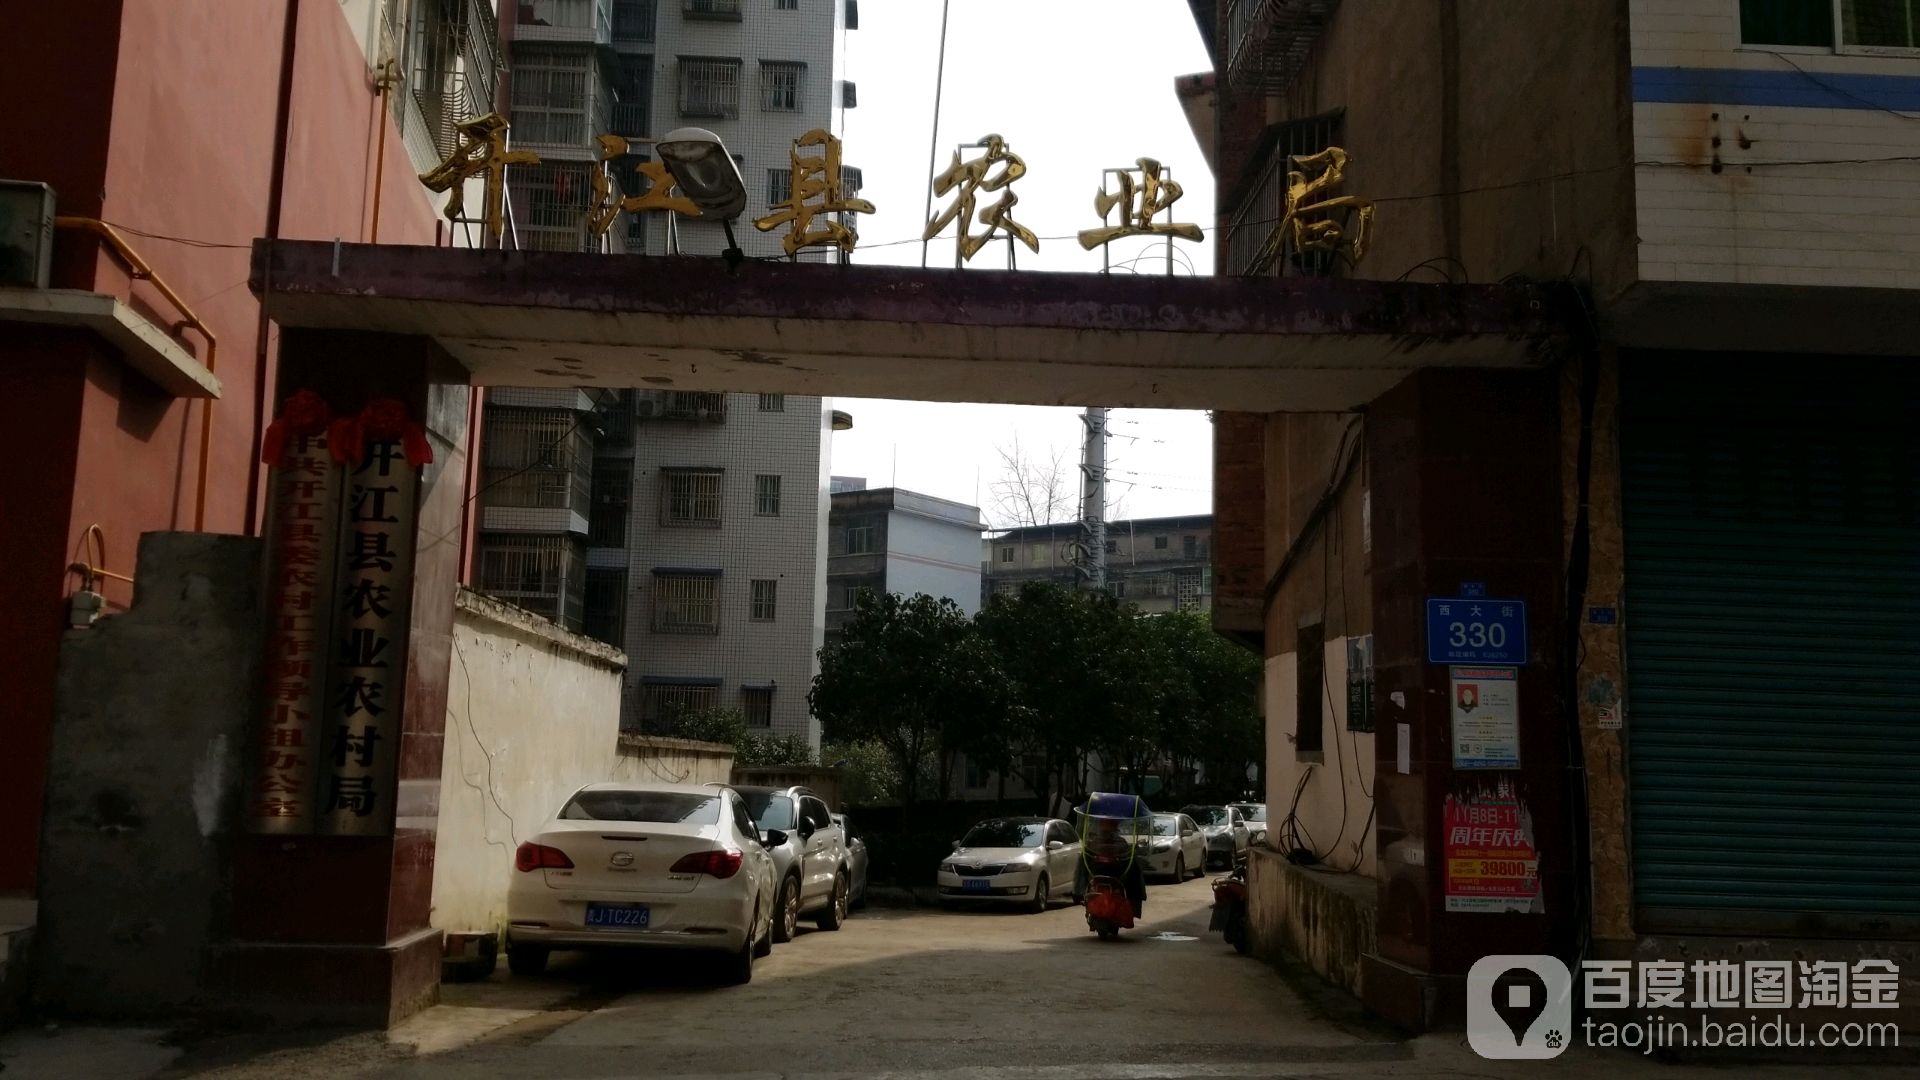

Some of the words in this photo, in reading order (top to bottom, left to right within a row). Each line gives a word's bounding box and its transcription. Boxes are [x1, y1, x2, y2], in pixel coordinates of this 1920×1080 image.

[1438, 604, 1515, 618] 西大街
[325, 437, 404, 817] 开江县农业农村局
[1448, 621, 1506, 648] 330
